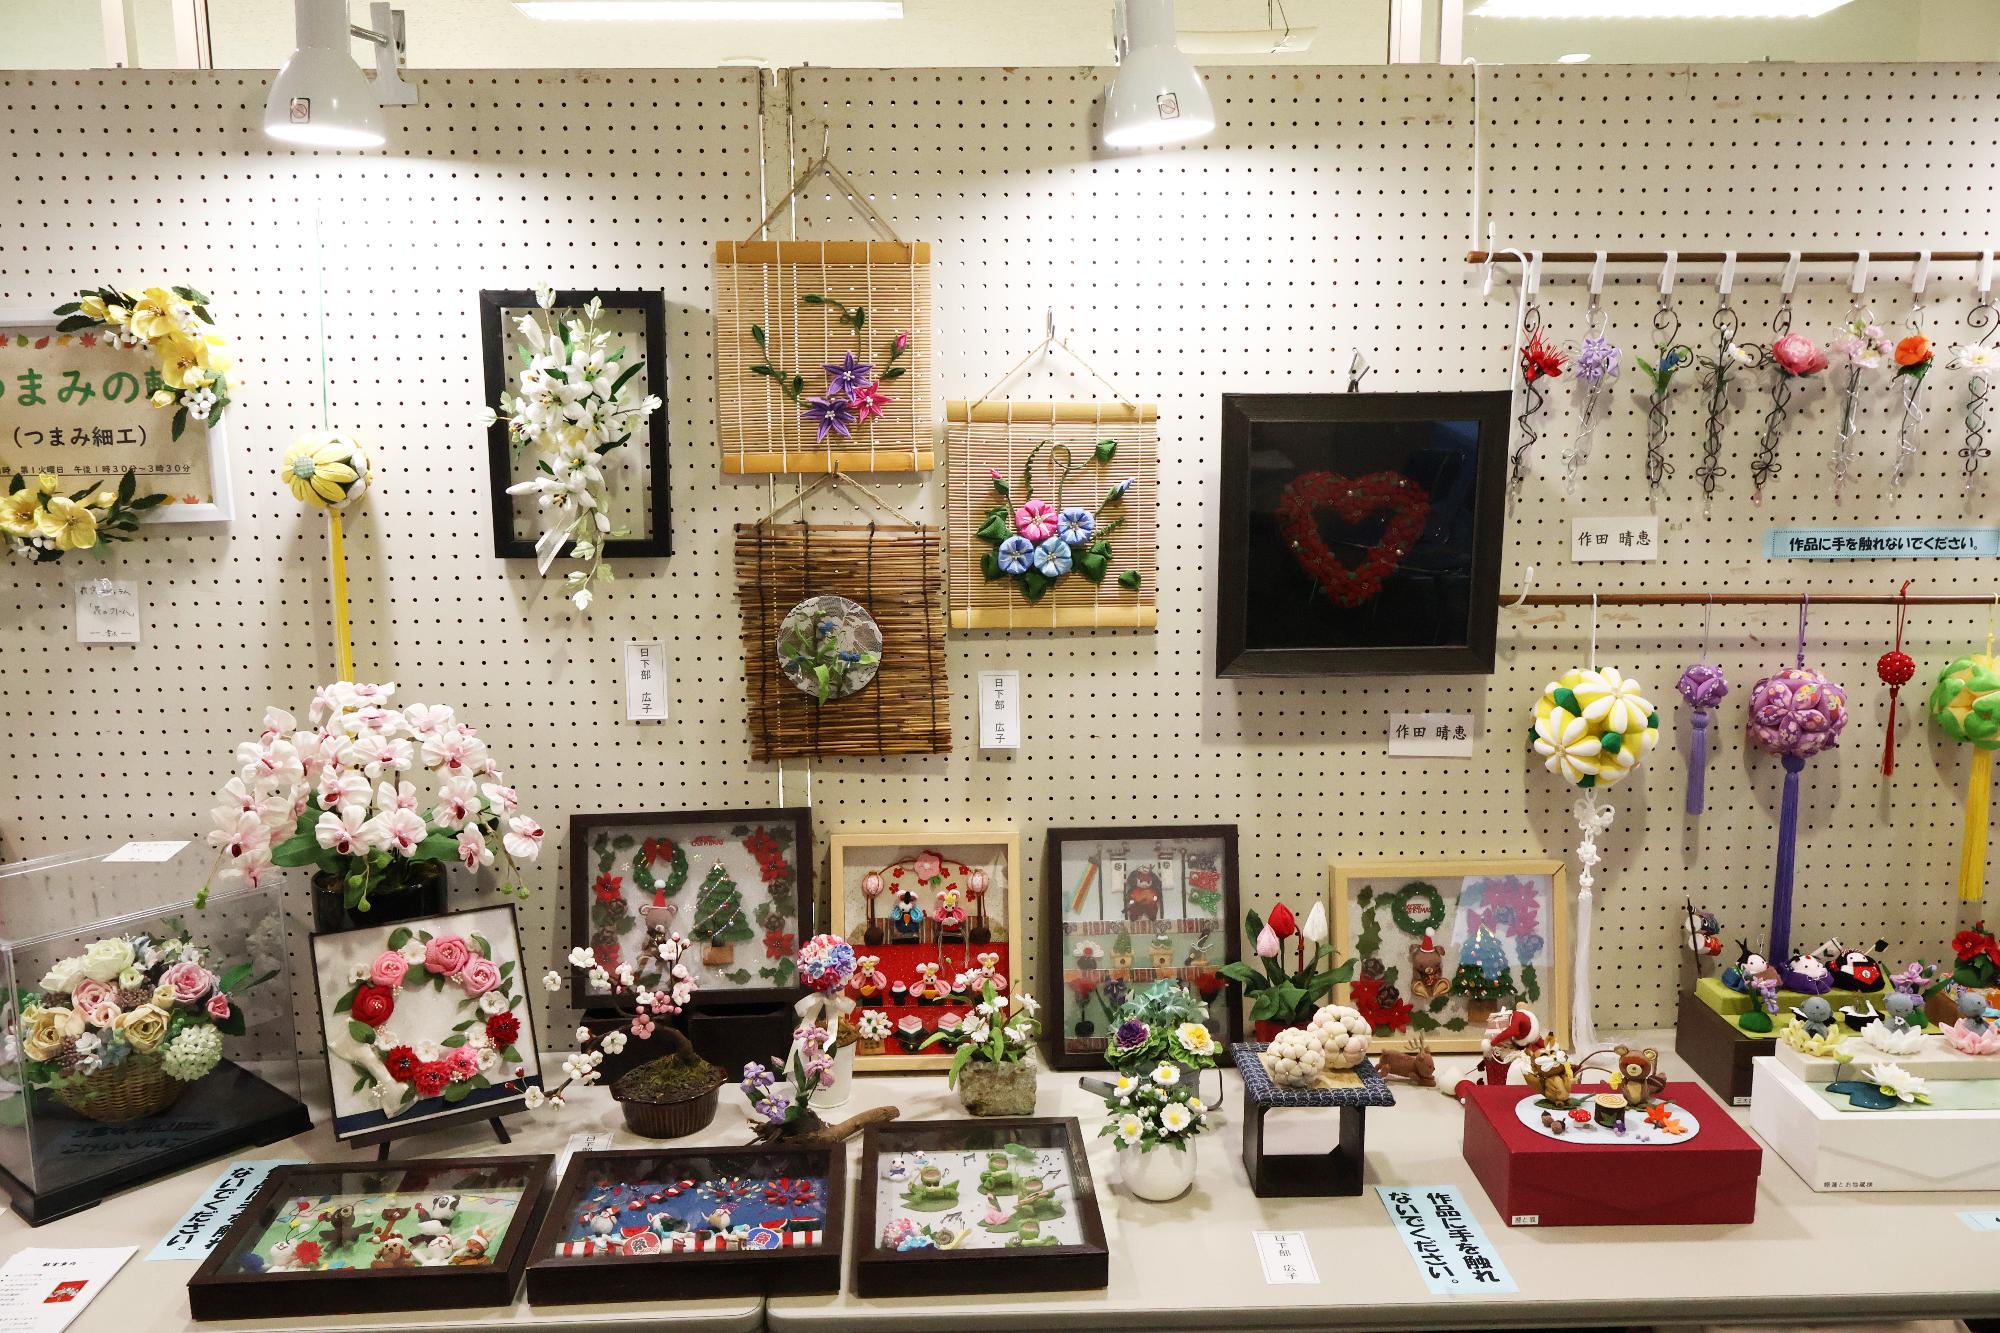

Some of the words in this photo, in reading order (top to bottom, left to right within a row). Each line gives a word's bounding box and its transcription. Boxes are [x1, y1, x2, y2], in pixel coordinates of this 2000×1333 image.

[0, 366, 164, 406] まみの
[1578, 531, 1609, 547] 作田
[1619, 530, 1651, 547] 晴恵
[1789, 537, 1978, 552] 作品に手を触れないでください。
[640, 648, 651, 680] 日下部
[994, 678, 1005, 710] 日下部
[995, 722, 1005, 743] 広子
[1396, 723, 1427, 740] 作田
[1435, 724, 1467, 741] 晴恵
[166, 1167, 255, 1251] ないでください。
[1388, 1191, 1459, 1284] ないでください。
[1426, 1192, 1500, 1282] 作品に手を触れ
